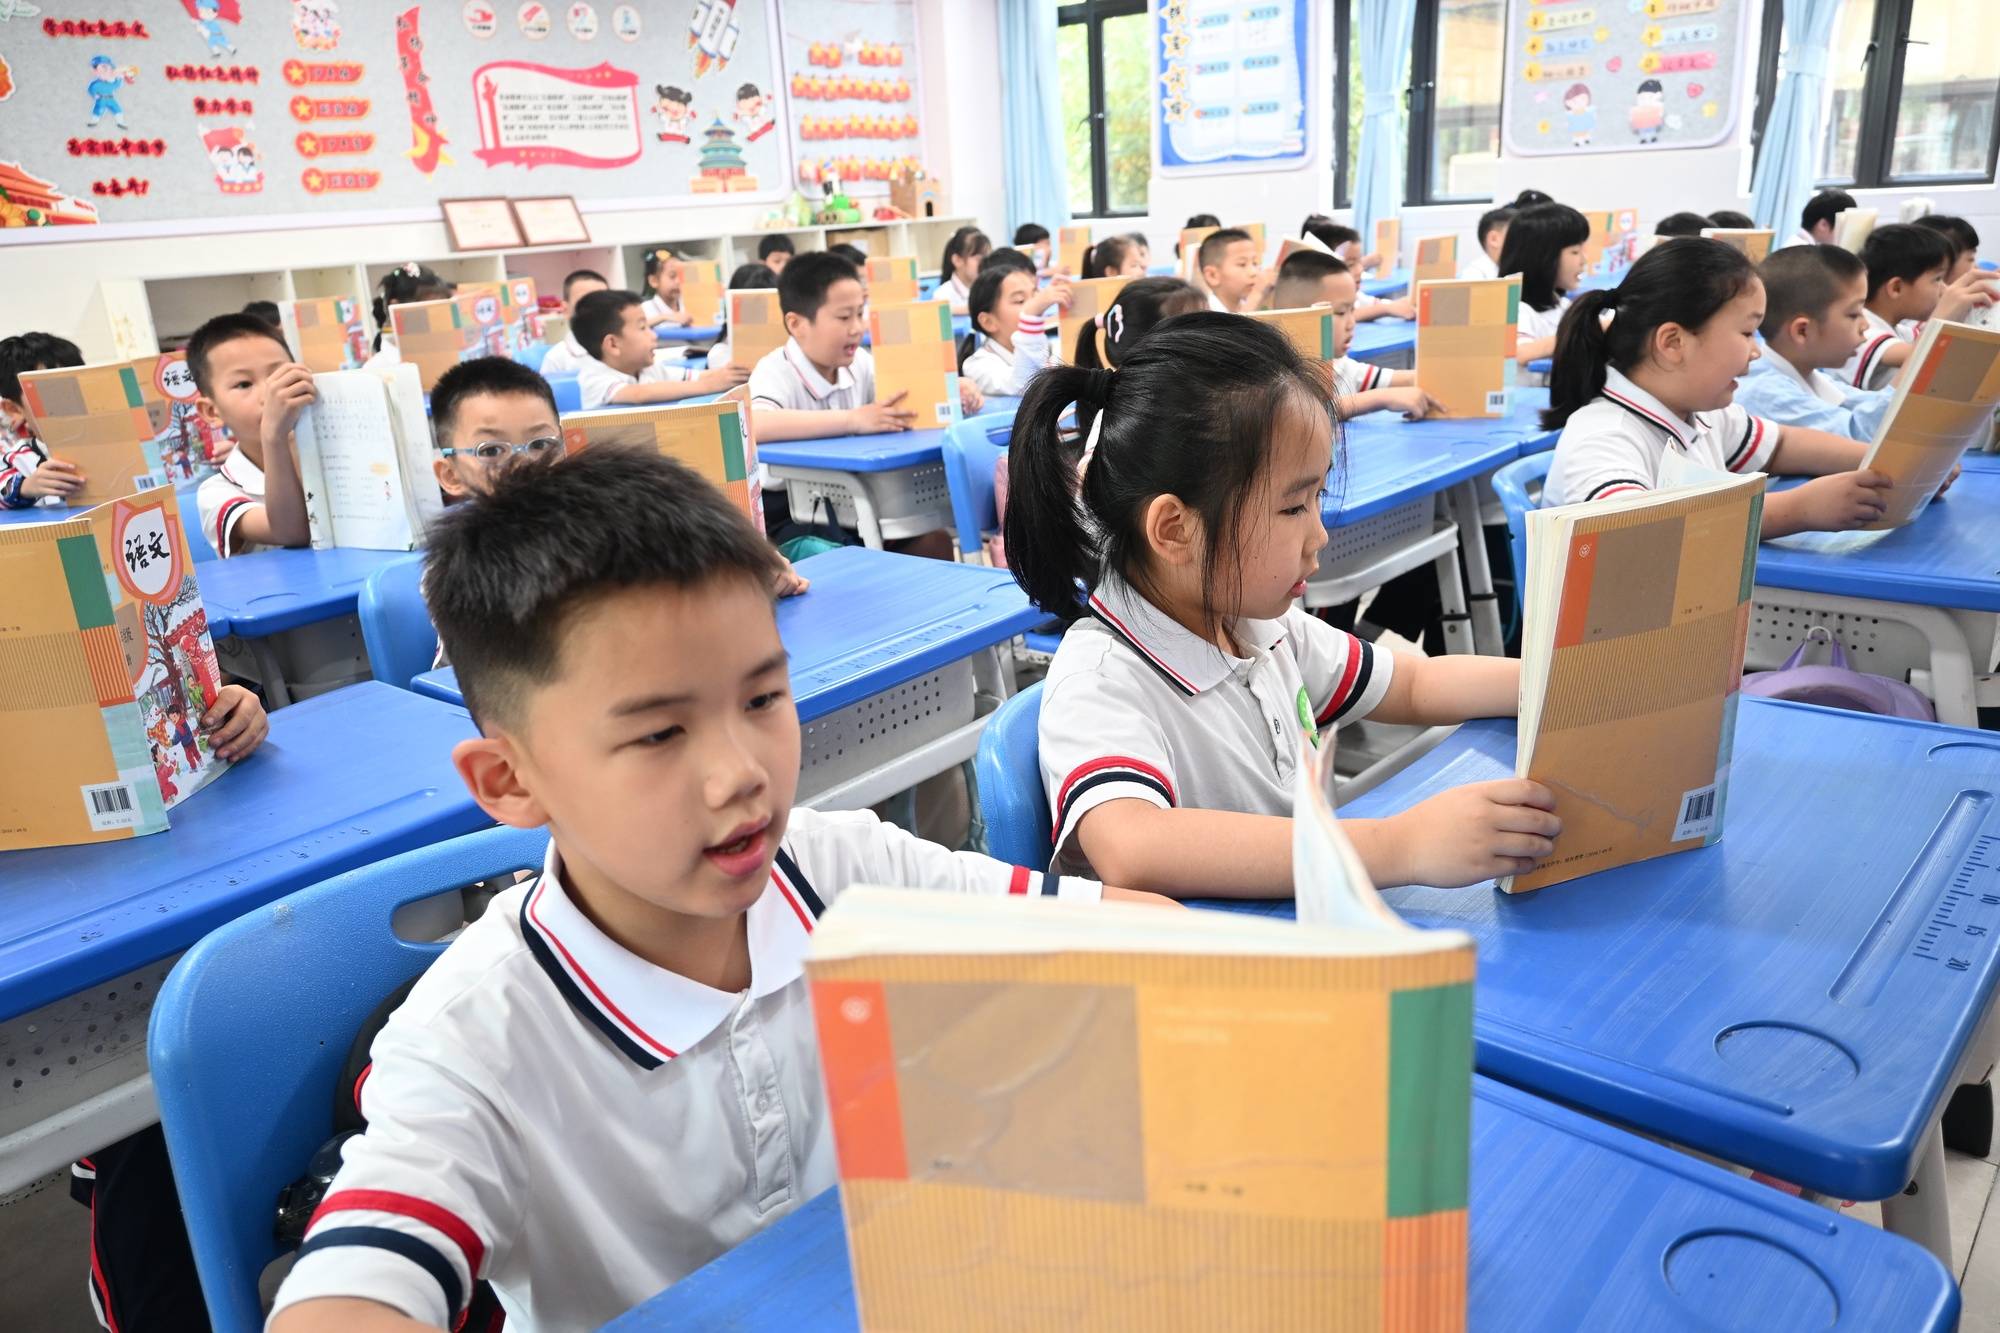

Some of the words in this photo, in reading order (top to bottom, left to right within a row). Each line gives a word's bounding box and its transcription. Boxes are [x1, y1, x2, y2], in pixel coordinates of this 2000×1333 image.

[163, 369, 195, 387] 语文
[125, 531, 171, 573] 语文
[1964, 925, 1987, 937] 15
[1945, 957, 1971, 971] 20
